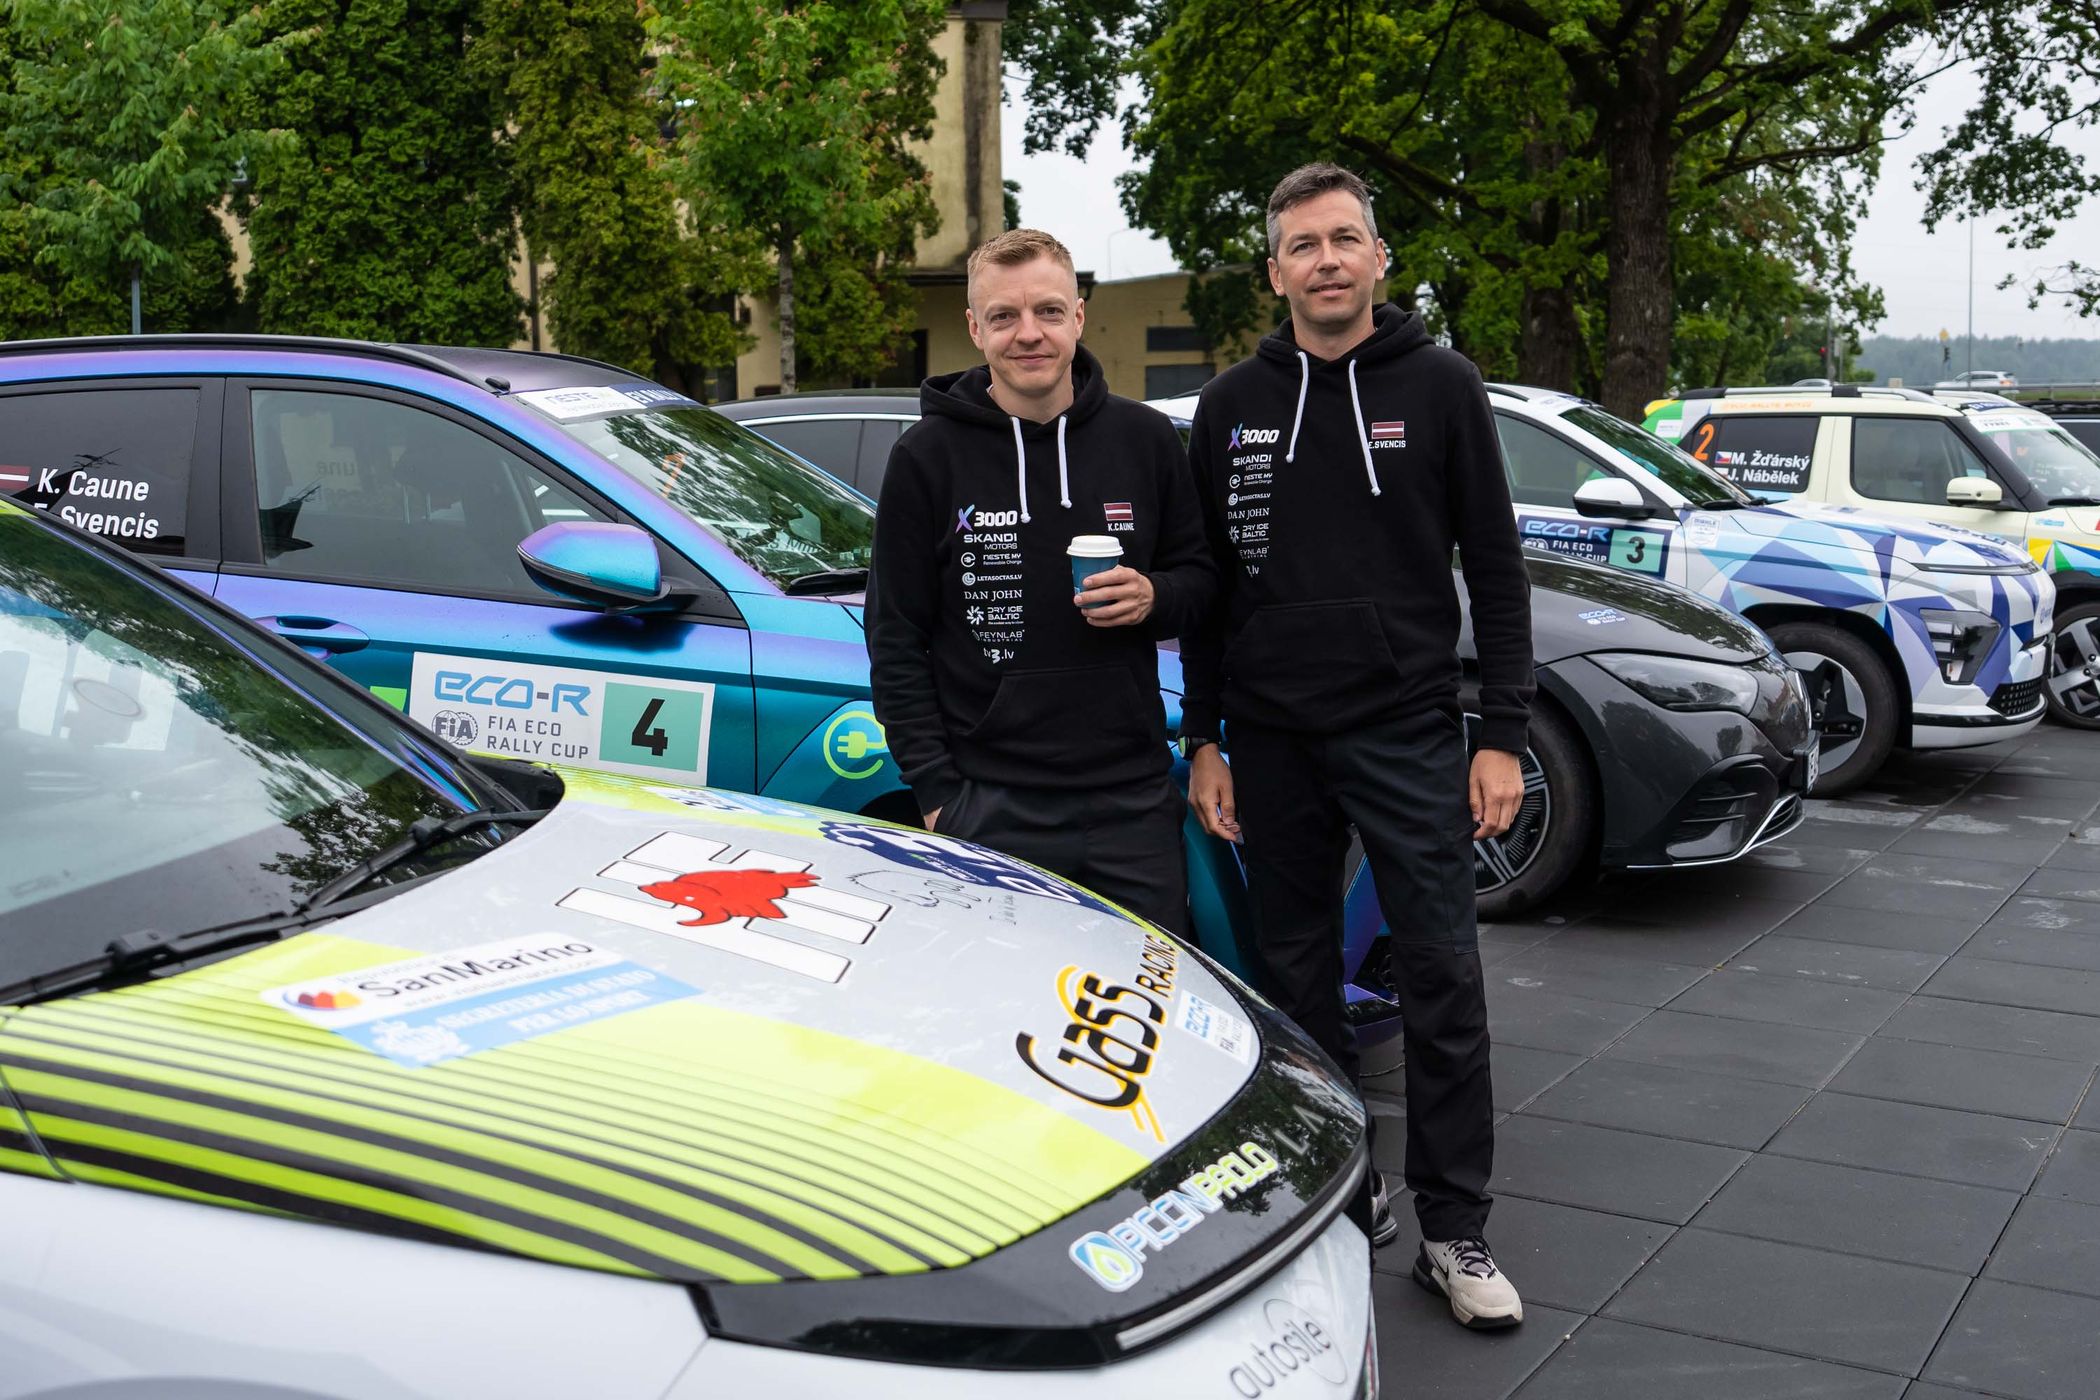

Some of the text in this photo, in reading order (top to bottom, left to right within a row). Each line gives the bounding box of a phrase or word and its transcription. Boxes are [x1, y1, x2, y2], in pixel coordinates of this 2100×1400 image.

[1693, 422, 1715, 461] 2
[1232, 454, 1272, 466] SKANDI
[1730, 449, 1810, 471] M. Žďárský
[37, 467, 149, 501] K. Caune
[1743, 466, 1799, 485] Nábělek
[61, 506, 159, 539] Svencis
[1246, 508, 1270, 520] JOHN
[963, 533, 1018, 543] SKANDI
[1242, 530, 1267, 538] BALTIC
[1552, 539, 1570, 550] FIA
[1572, 542, 1594, 551] ECO
[1626, 536, 1646, 564] 3
[964, 589, 1023, 602] DAN JOHN
[987, 613, 1020, 621] BALTIC
[1007, 605, 1024, 613] ICE
[488, 715, 562, 737] FIA ECO
[631, 698, 669, 757] 4
[487, 735, 589, 760] RALLY CUP
[1134, 933, 1179, 999] RACING
